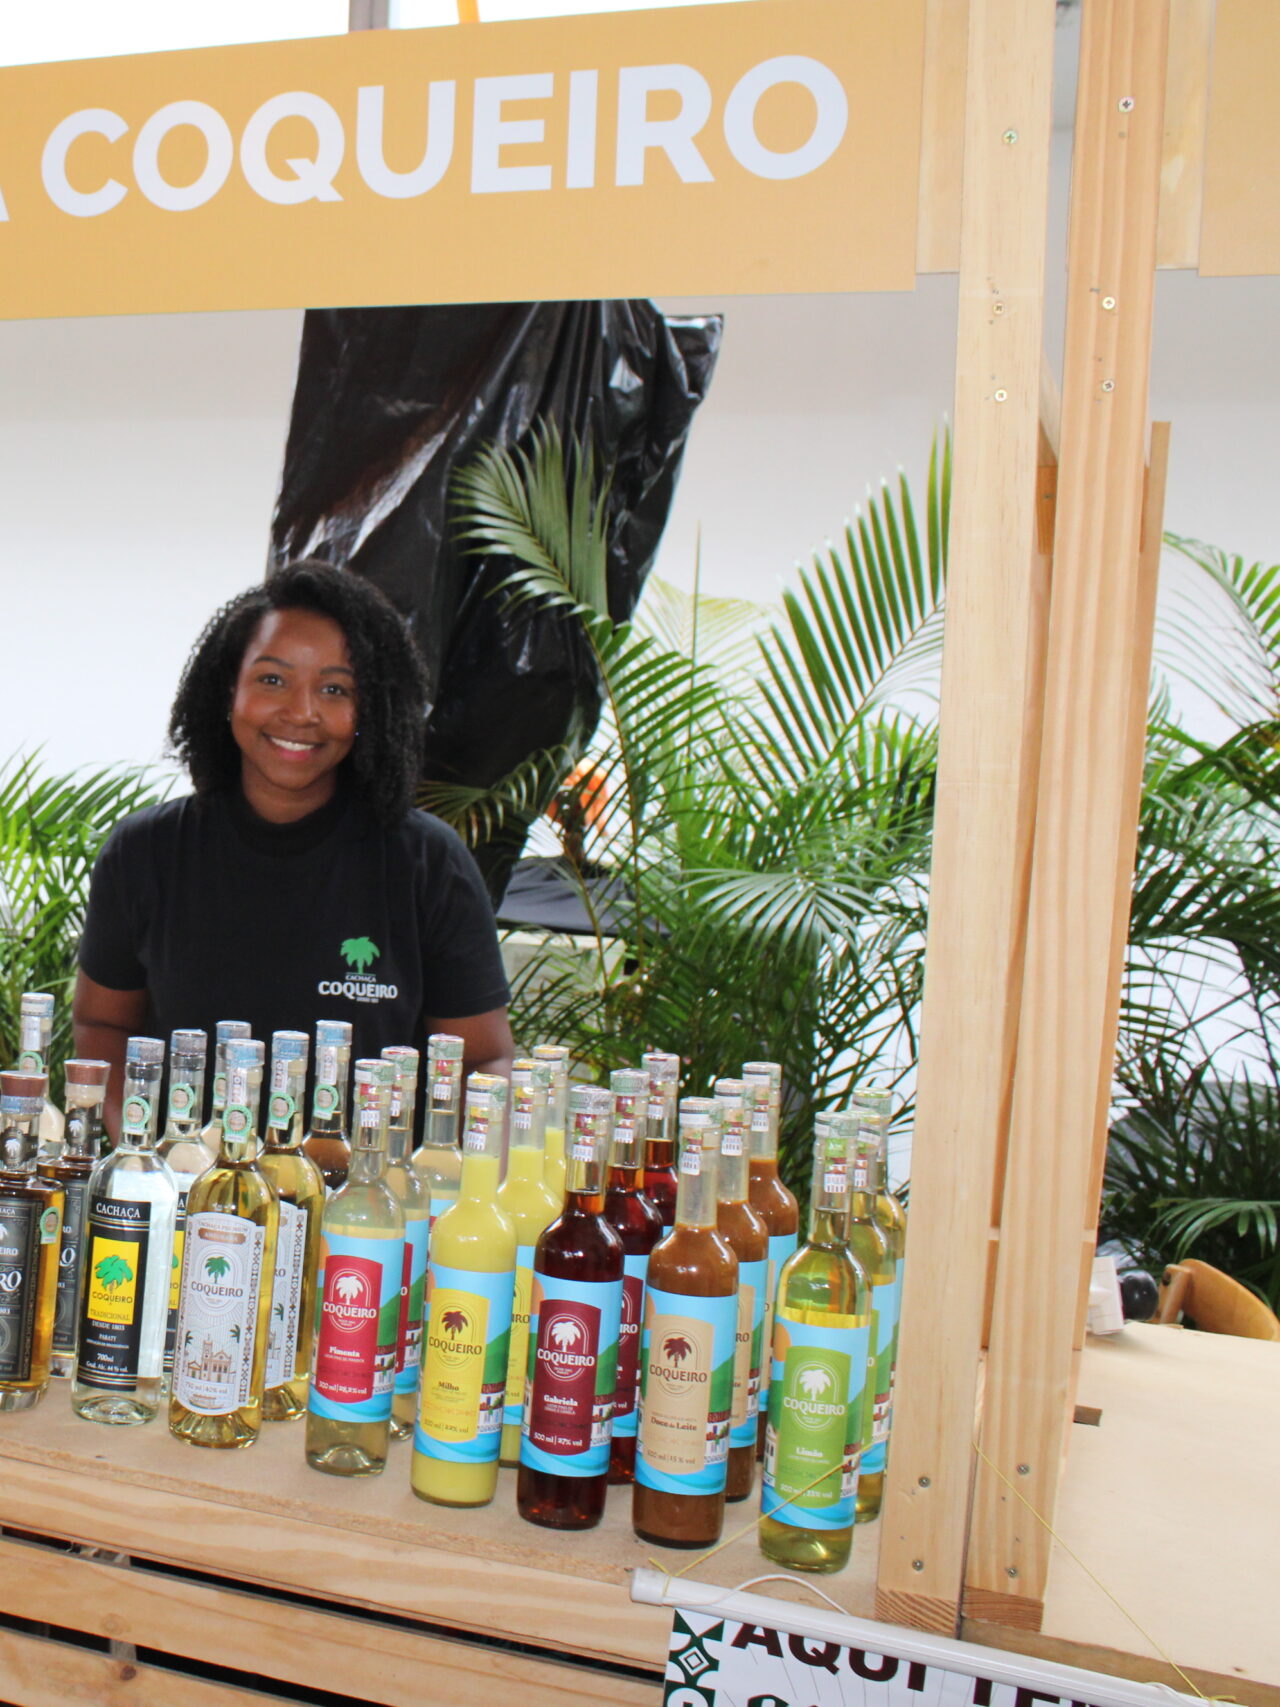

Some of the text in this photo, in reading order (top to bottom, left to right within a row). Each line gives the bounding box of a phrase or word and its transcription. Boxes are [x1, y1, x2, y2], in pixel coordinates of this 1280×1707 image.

[40, 54, 849, 218] COQUEIRO
[317, 980, 399, 1000] COQUEIRO
[95, 1202, 141, 1219] CACHAÇA
[92, 1290, 133, 1304] COQUEIRO
[191, 1280, 244, 1299] COQUEIRO
[323, 1301, 377, 1319] COQUEIRO
[329, 1345, 360, 1357] Pimenta
[428, 1336, 483, 1355] COQUEIRO
[536, 1347, 596, 1367] COQUEIRO
[649, 1364, 708, 1383] COQUEIRO
[438, 1381, 460, 1392] Milho
[543, 1394, 579, 1406] Gabriela
[783, 1396, 846, 1415] COQUEIRO
[650, 1416, 668, 1427] Doce
[676, 1422, 697, 1431] Leite
[572, 1439, 583, 1447] vol
[795, 1446, 824, 1458] Limão
